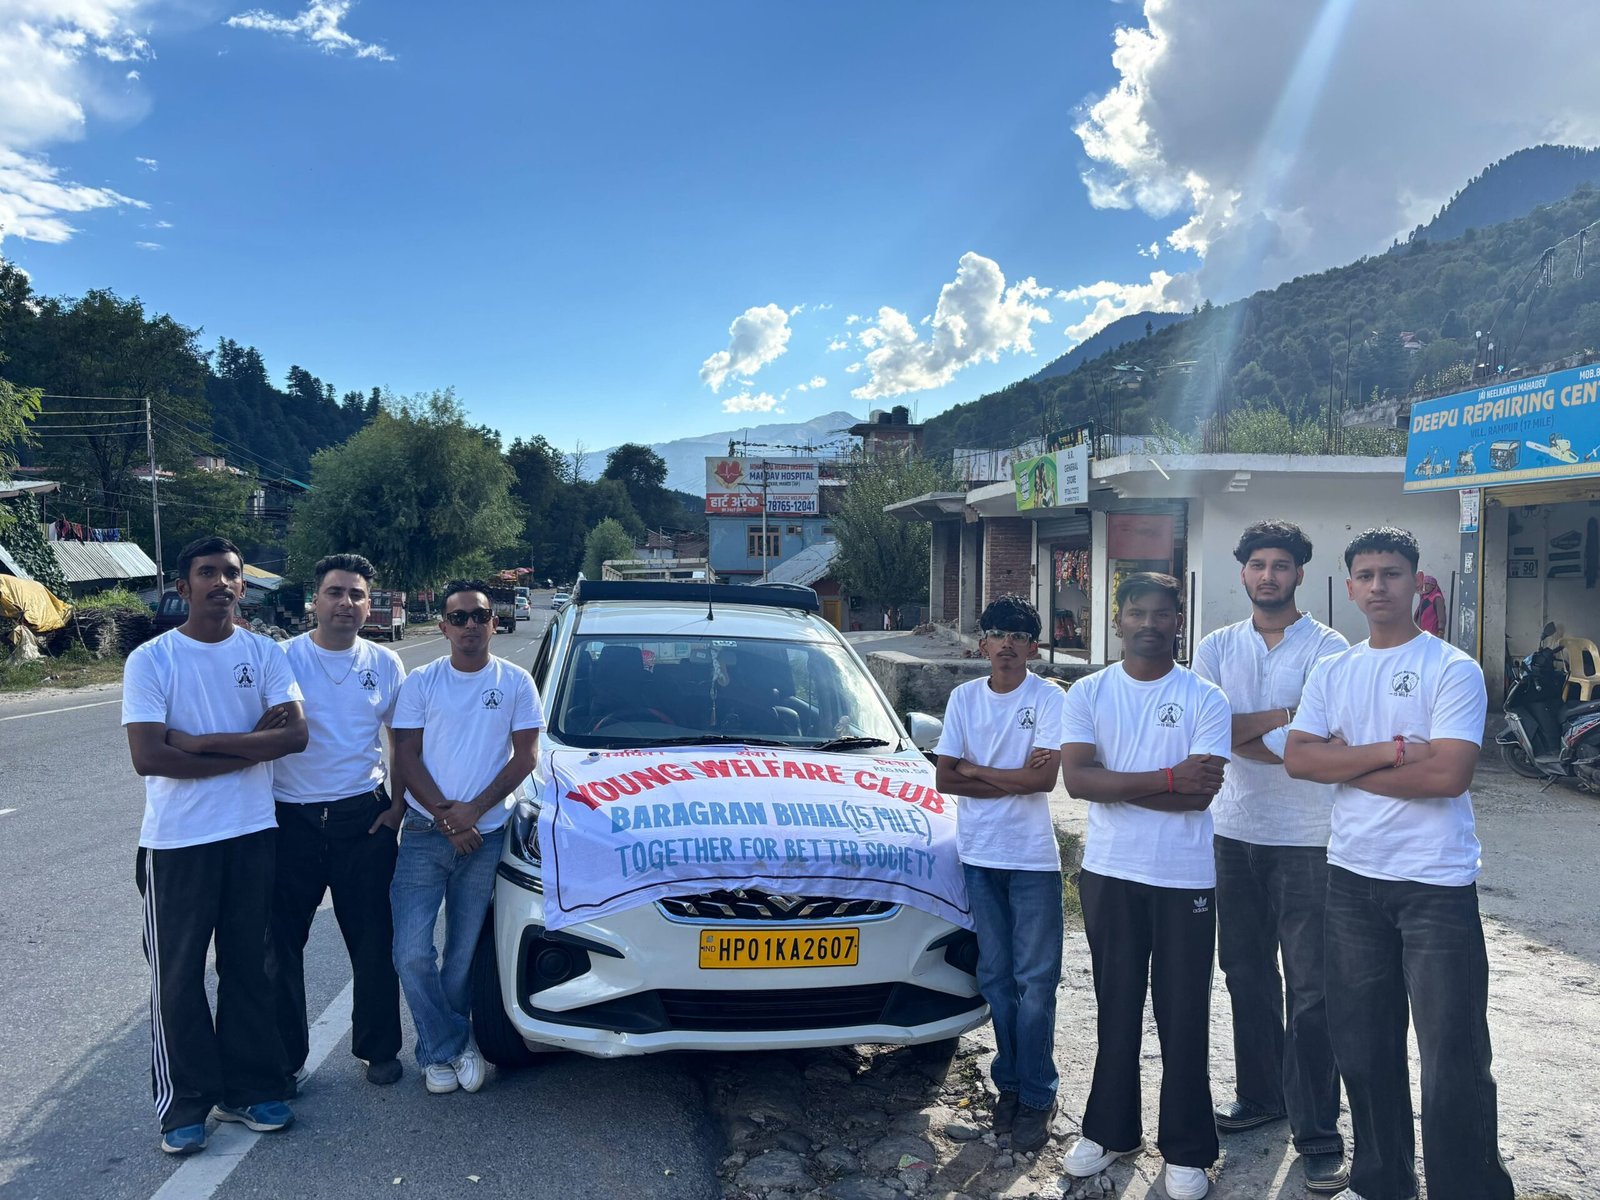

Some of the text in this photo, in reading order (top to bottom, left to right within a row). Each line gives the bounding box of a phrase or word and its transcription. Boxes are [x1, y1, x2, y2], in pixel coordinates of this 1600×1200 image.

[1487, 384, 1517, 399] NEELKANTH
[1518, 376, 1548, 392] MAHADEV
[1412, 380, 1600, 433] DEEPU REPAIRING CEN
[1488, 420, 1518, 435] RAMPUR
[1532, 414, 1555, 428] MILE)
[781, 471, 815, 480] HOSPITAL
[710, 494, 758, 507] हार्ट अटैक
[767, 500, 815, 511] 78765-12041
[565, 759, 945, 814] YOUNG WELFARE CLUB
[610, 801, 767, 833] BARAGRAN
[614, 837, 936, 880] TOGETHER FOR BETTER SOCIETY
[719, 936, 855, 961] HP01KA2607
